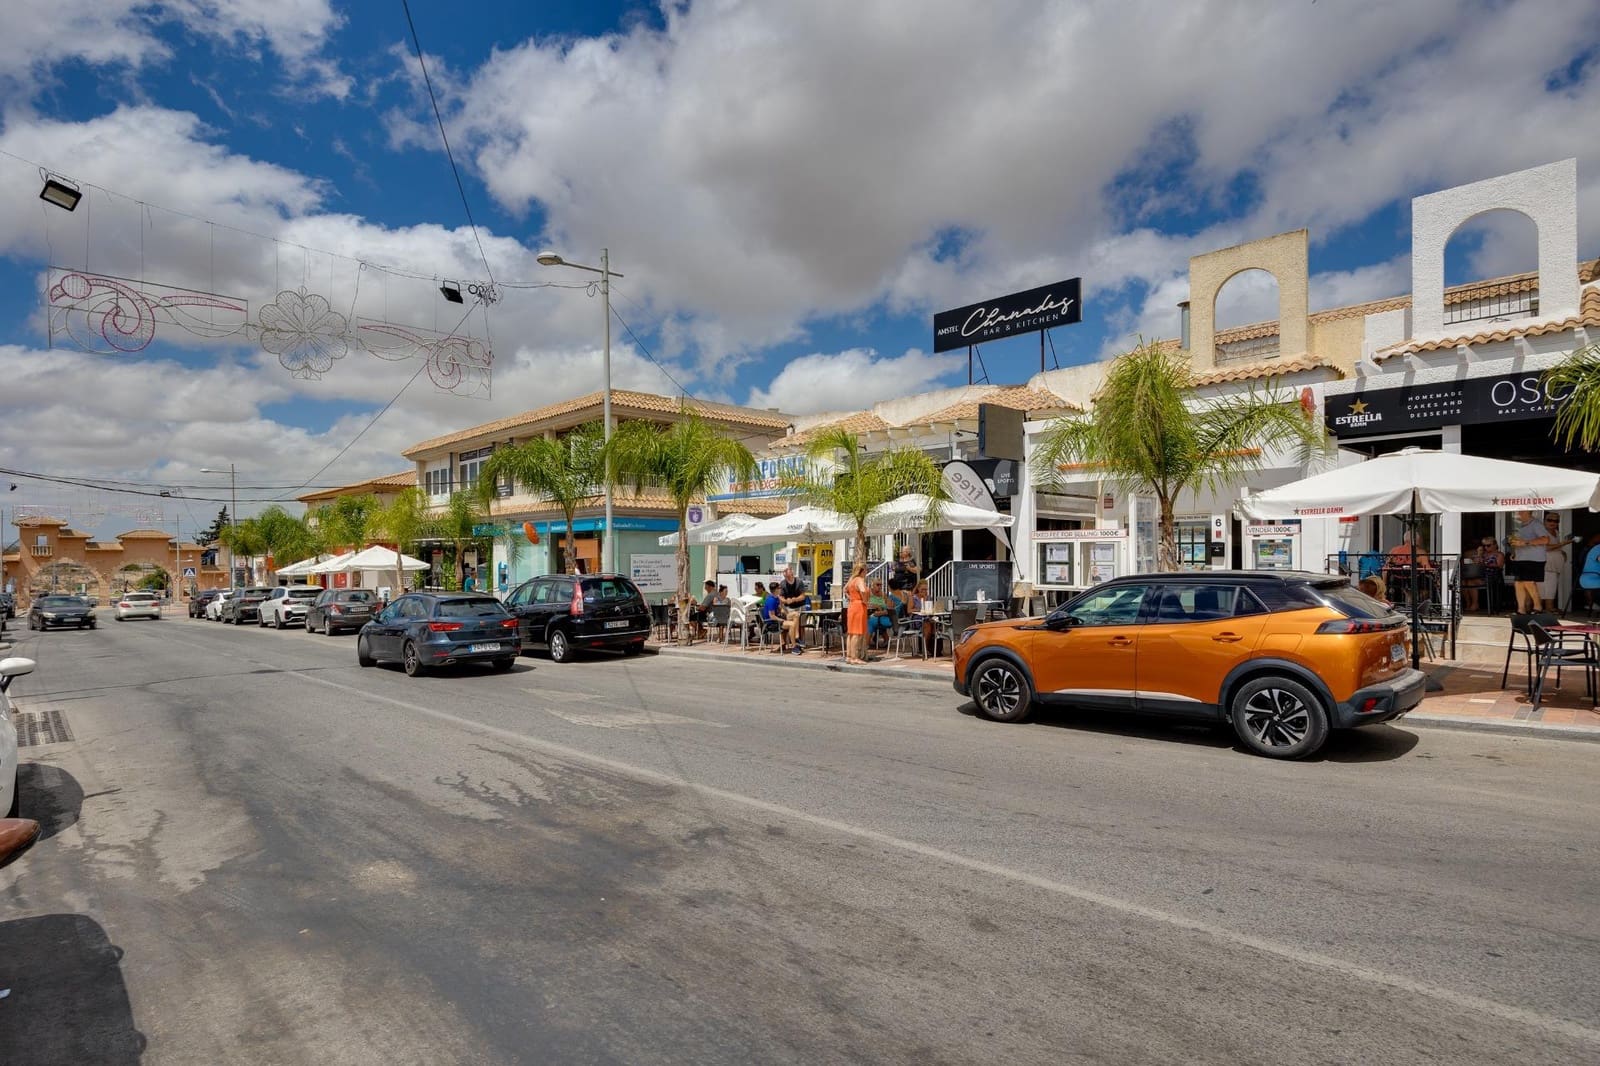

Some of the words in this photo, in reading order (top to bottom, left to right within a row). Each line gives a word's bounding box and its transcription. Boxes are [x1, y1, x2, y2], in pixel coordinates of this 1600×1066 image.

[983, 328, 1001, 336] BAR
[1016, 313, 1059, 328] KITCHEN
[937, 325, 959, 336] AMSTEL
[1408, 390, 1463, 401] HOMEMADE
[1407, 402, 1439, 410] CAKES
[1409, 408, 1461, 418] DESSERTS
[1335, 412, 1382, 425] ESTRELLA
[1501, 498, 1531, 506] ESTRELLA
[1533, 497, 1555, 505] DAMM
[1215, 518, 1222, 527] 6
